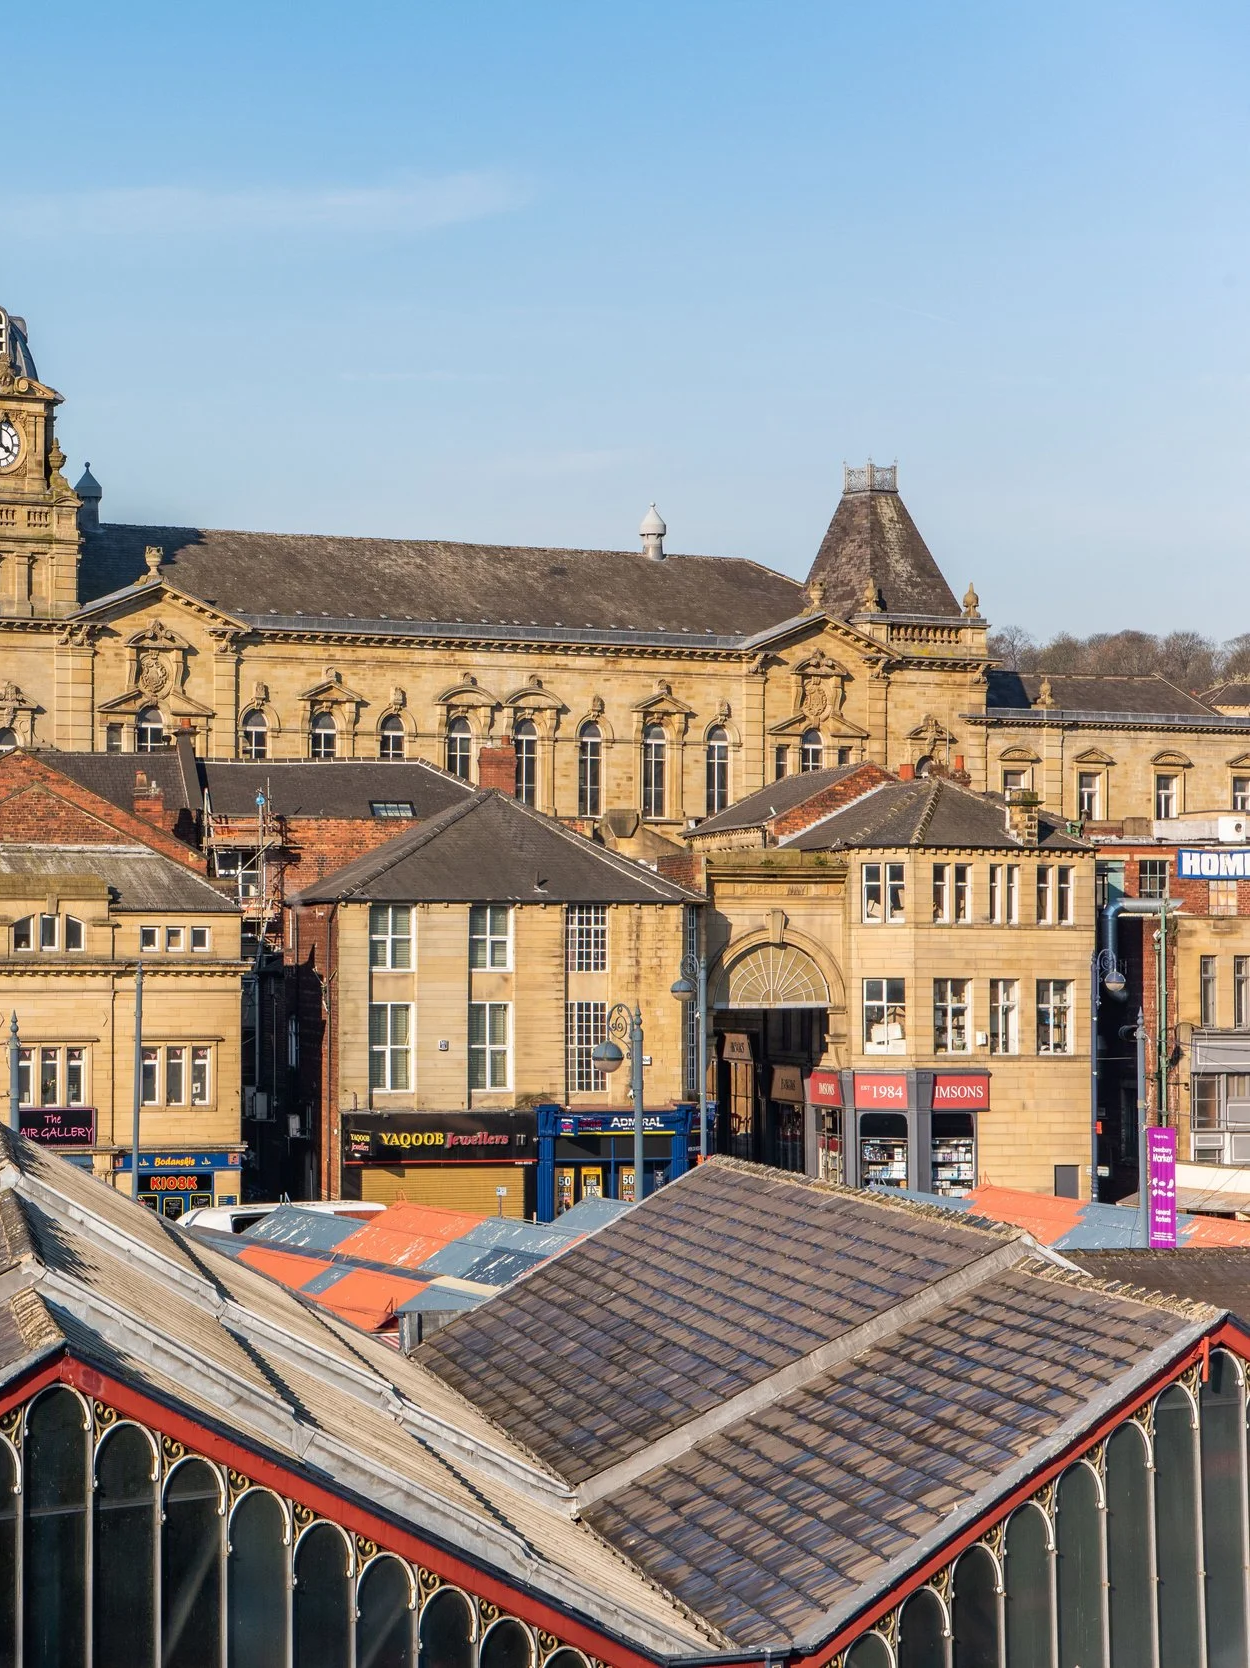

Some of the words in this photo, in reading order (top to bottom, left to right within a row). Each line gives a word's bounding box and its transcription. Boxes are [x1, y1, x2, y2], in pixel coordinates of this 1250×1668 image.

[818, 1082, 835, 1096] IMSONS
[872, 1085, 903, 1099] 1984
[934, 1084, 984, 1099] IMSONS
[44, 1114, 62, 1124] The
[610, 1116, 665, 1128] ADMRAL
[20, 1127, 39, 1138] AIR
[40, 1126, 94, 1142] GALLERY
[350, 1133, 370, 1143] YAQOOB
[380, 1132, 444, 1148] YAQOOB
[446, 1131, 509, 1148] Jewellers
[150, 1176, 198, 1191] KIOSK
[558, 1176, 571, 1186] 50
[622, 1174, 634, 1184] 50
